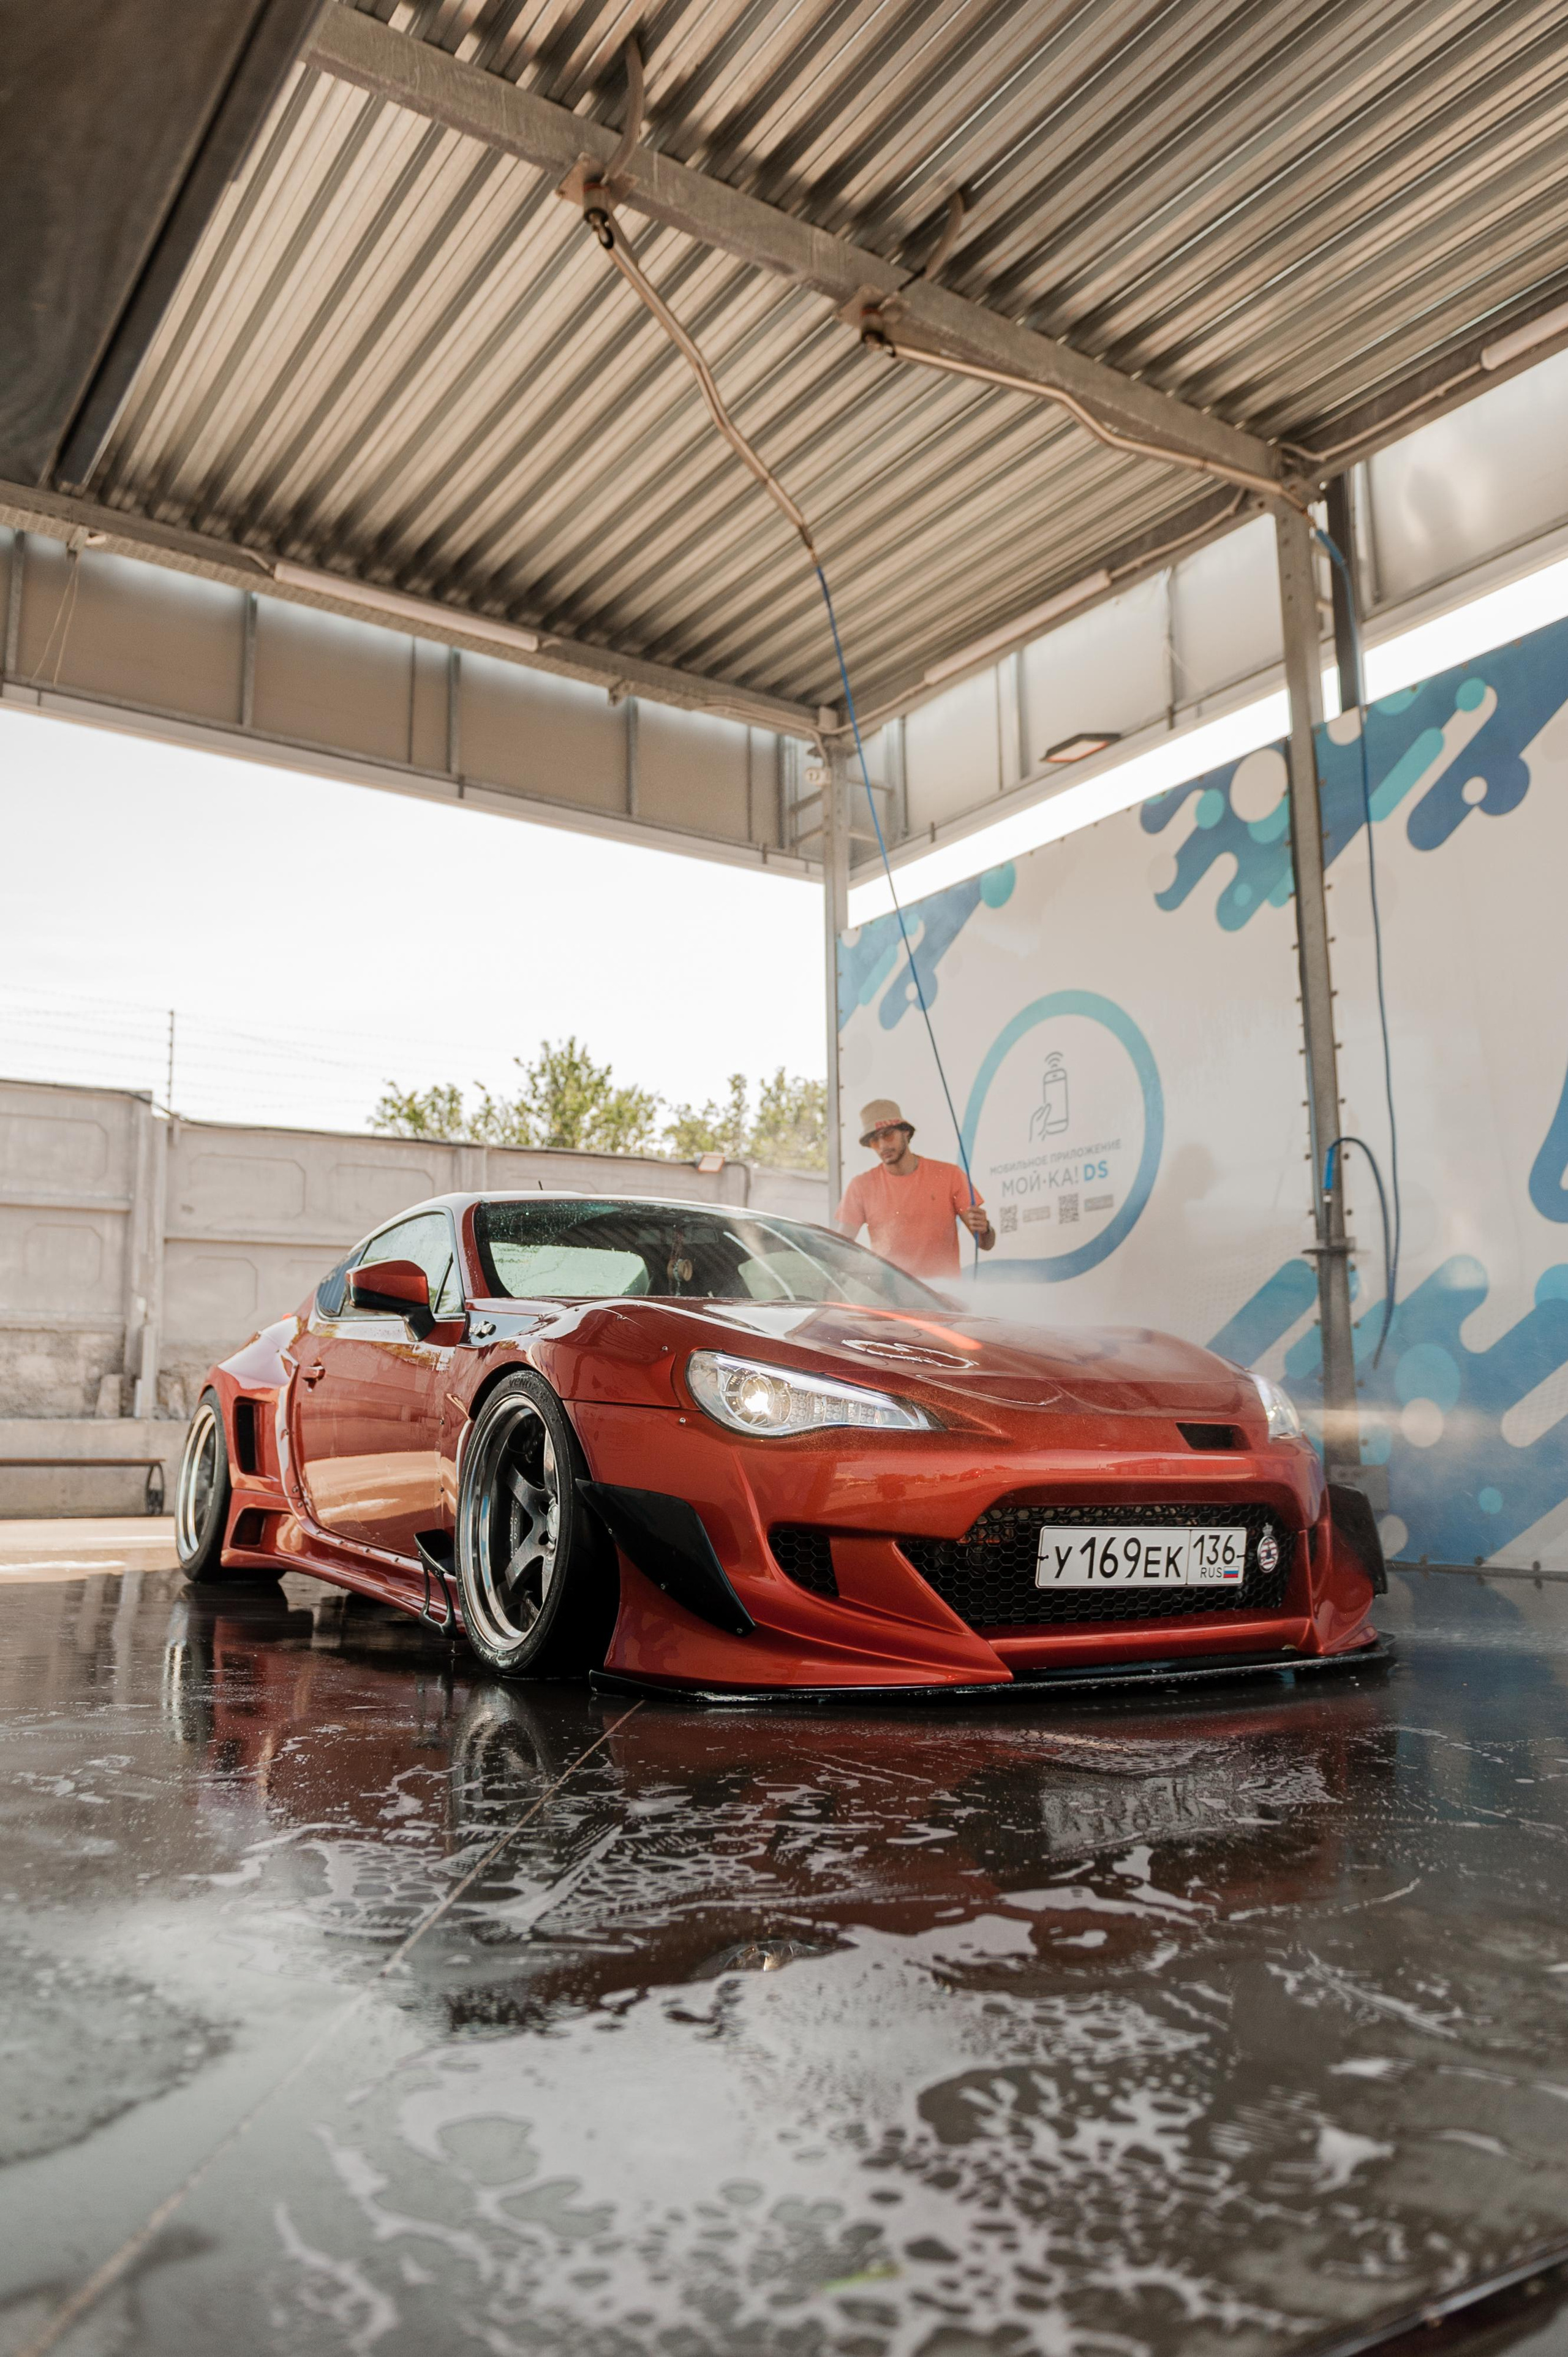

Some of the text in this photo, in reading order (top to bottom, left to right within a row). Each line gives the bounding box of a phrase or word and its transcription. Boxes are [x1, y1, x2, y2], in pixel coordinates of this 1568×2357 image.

[990, 1138, 1121, 1175] МОБИЛЬНОЕ ПРИЛОЖЕНИЕ
[1084, 1160, 1109, 1182] DS
[1193, 1534, 1235, 1566] 136
[1200, 1567, 1222, 1578] RUS
